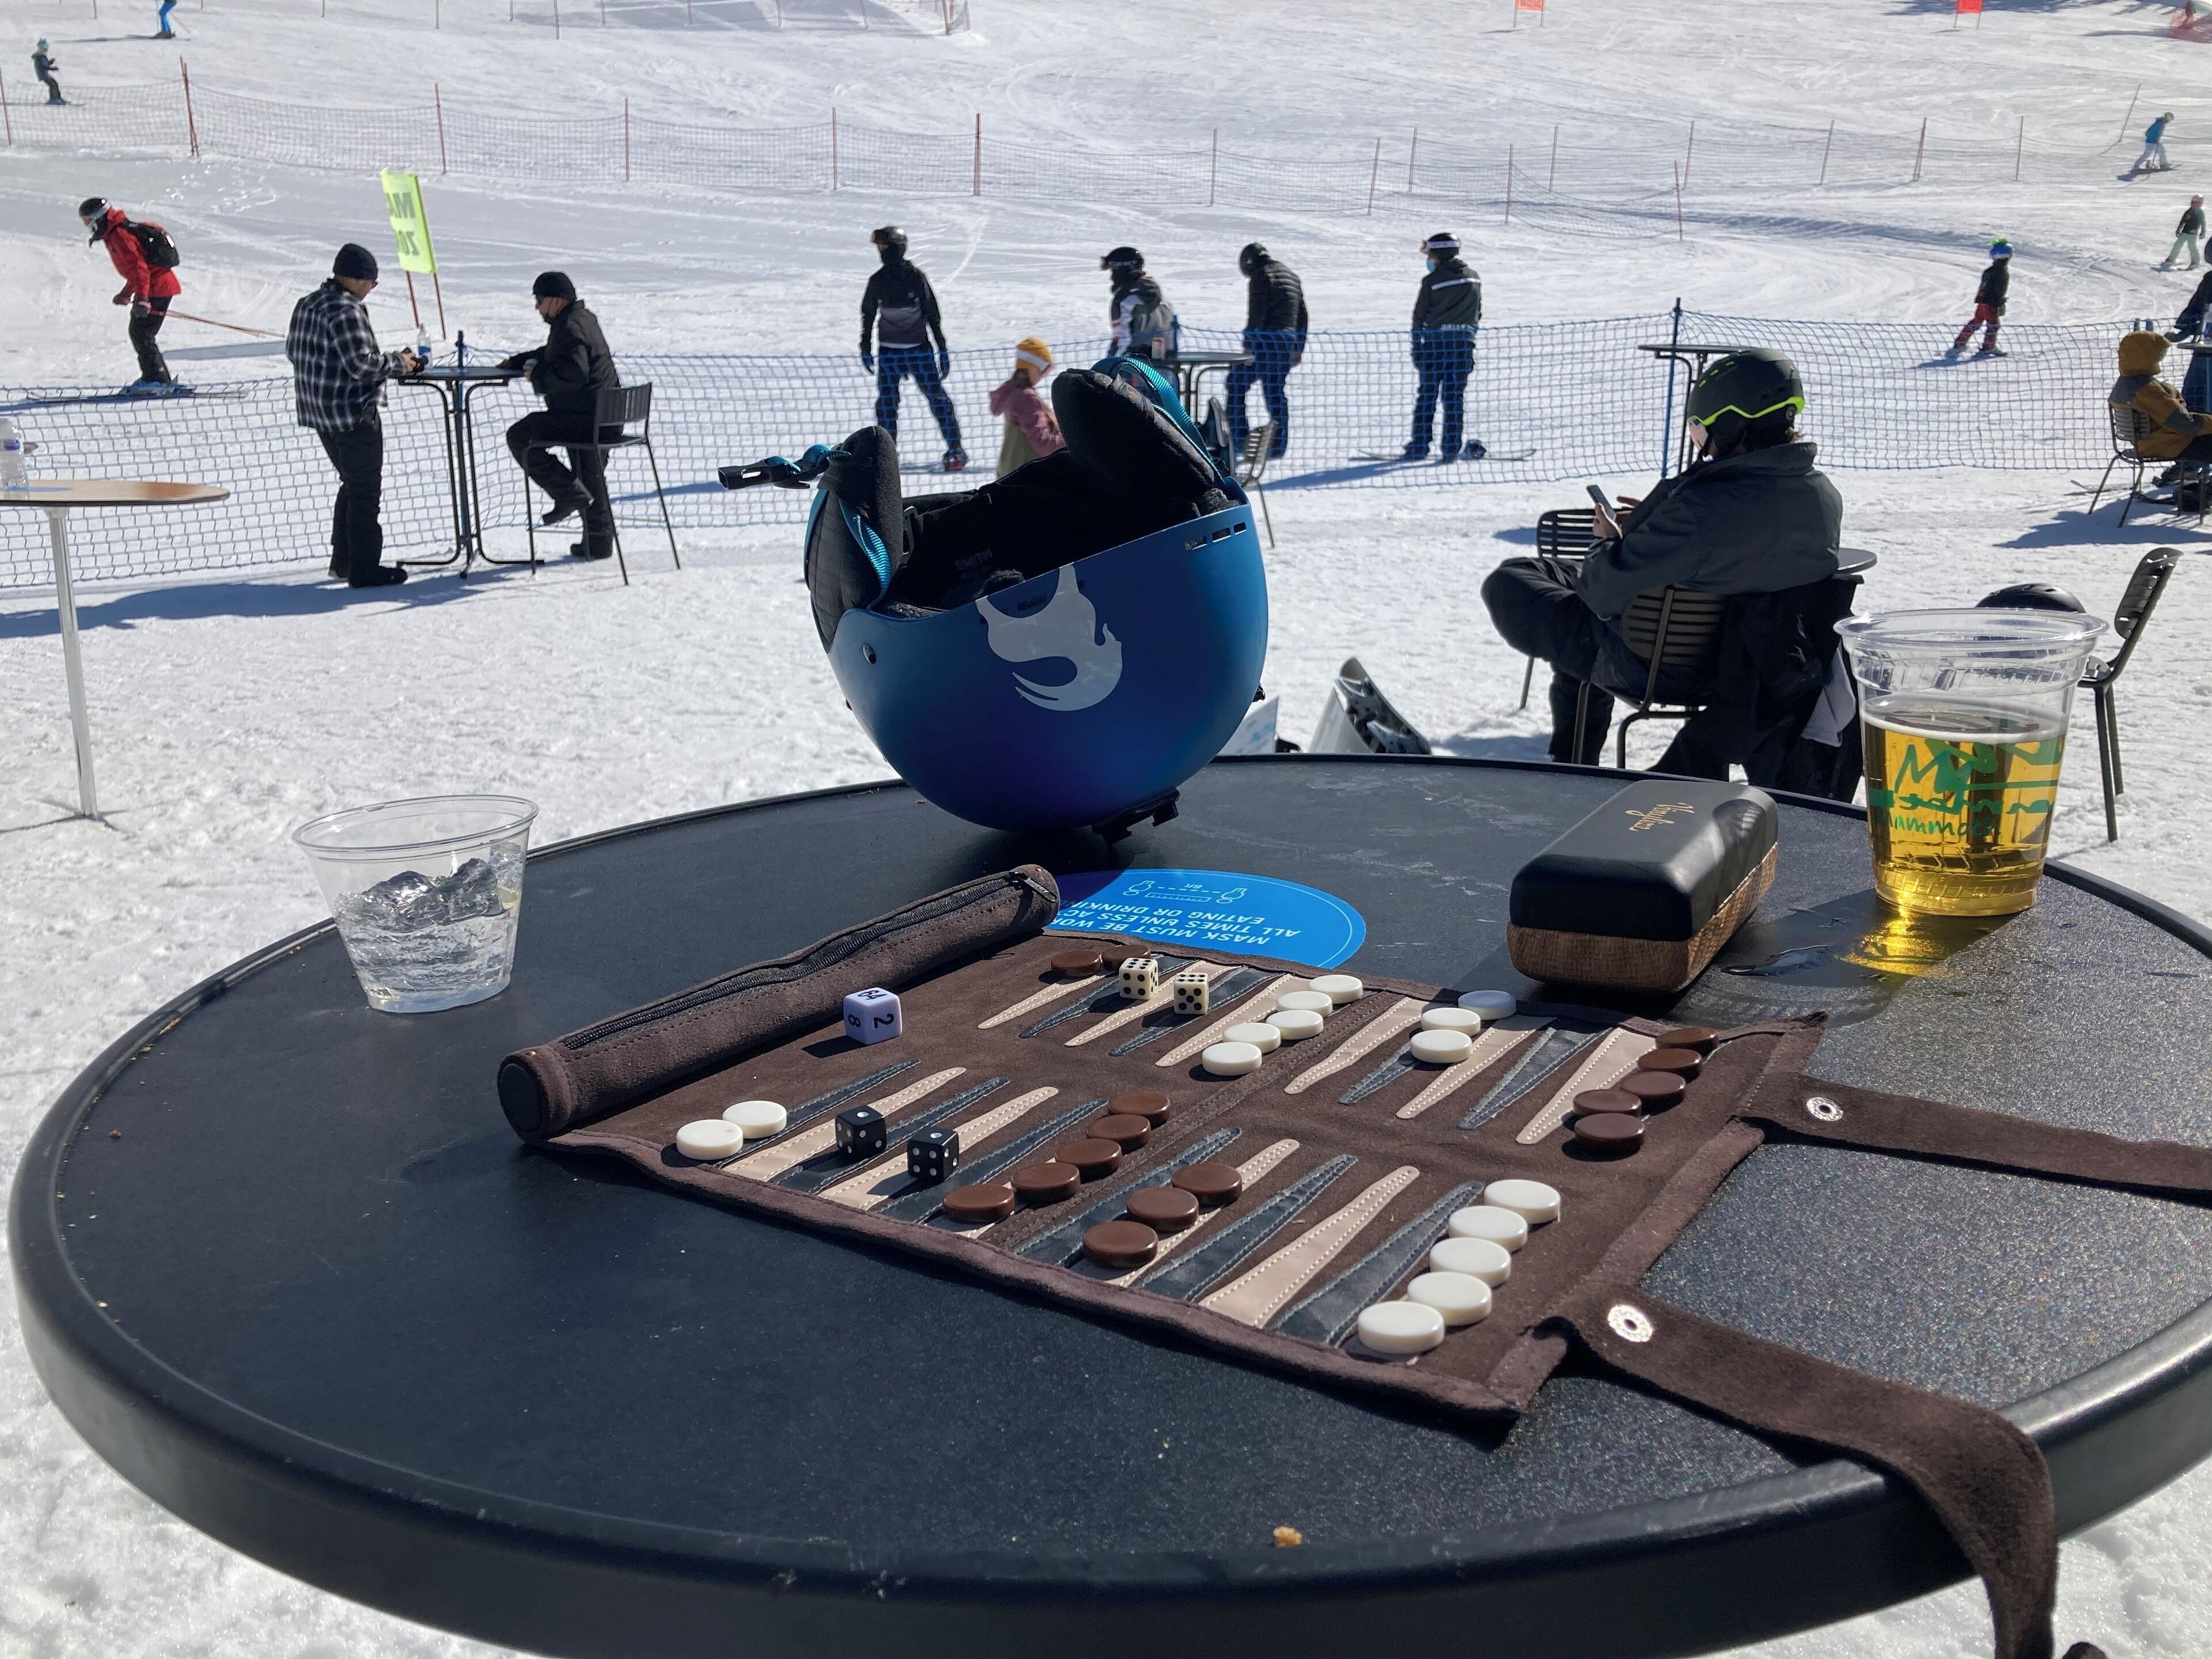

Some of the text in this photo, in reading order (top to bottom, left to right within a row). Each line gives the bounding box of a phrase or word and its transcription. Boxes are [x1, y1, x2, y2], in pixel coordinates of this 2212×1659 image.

[1153, 908, 1183, 916] OR
[1187, 911, 1266, 925] EATING
[1097, 913, 1179, 926] UNLESS
[1098, 922, 1130, 931] BE
[1131, 926, 1199, 938] MUST
[1184, 921, 1251, 933] TIMES
[1262, 927, 1302, 937] ALL
[1202, 932, 1271, 945] MASK
[848, 1014, 861, 1027] 8
[874, 1014, 894, 1029] 2
